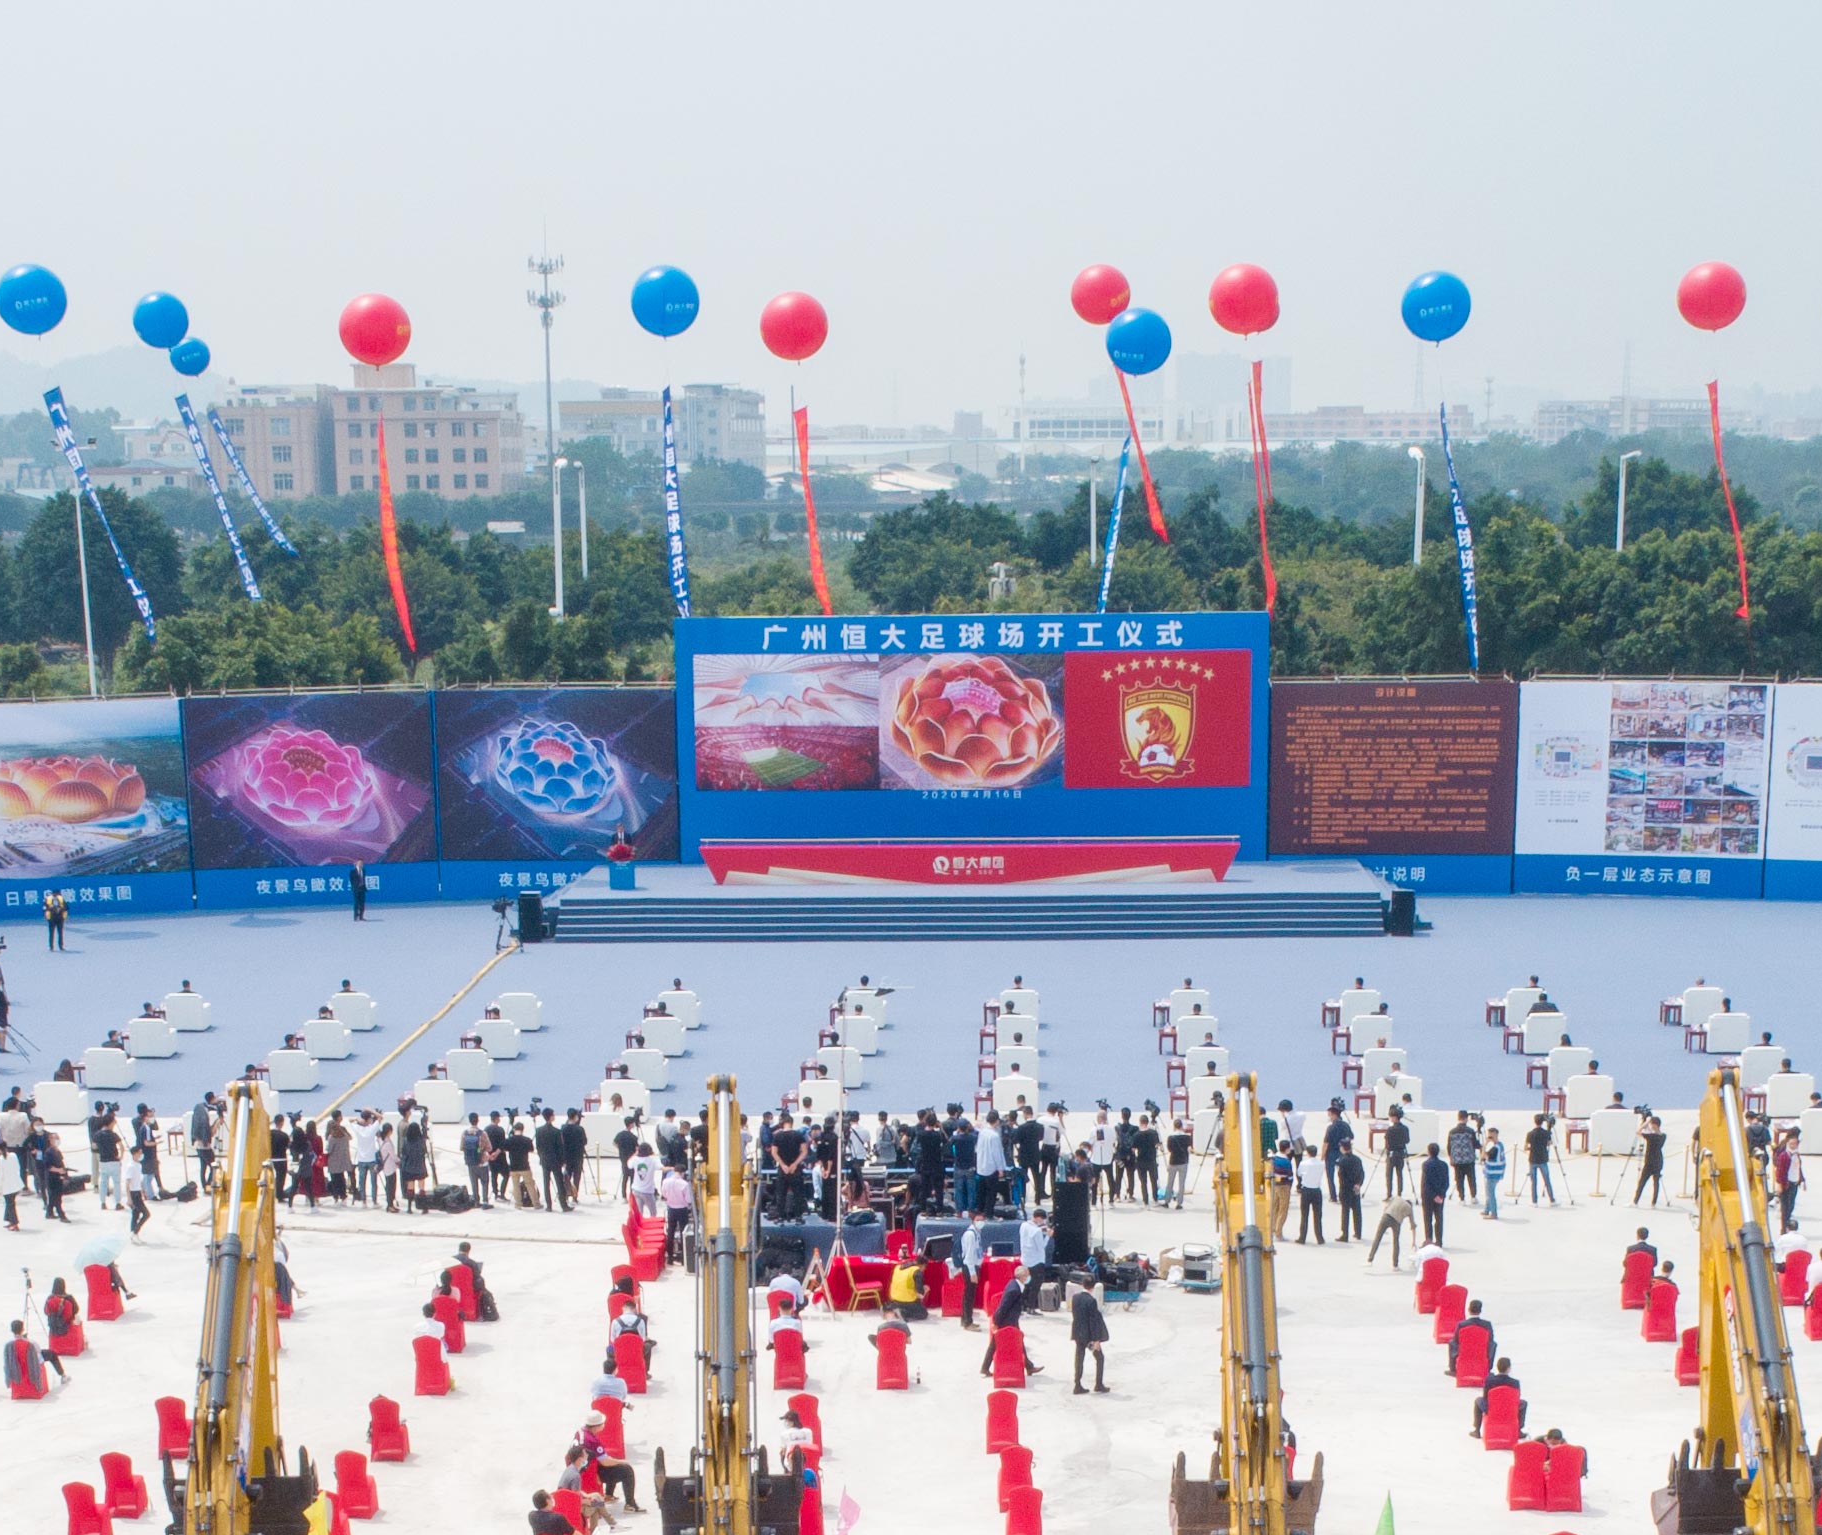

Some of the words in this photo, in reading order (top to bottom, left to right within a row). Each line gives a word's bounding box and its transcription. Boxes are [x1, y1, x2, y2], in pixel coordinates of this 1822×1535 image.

[761, 621, 1184, 650] 广州恒大足球场开工仪式
[922, 790, 1023, 800] 2020年4月16日
[952, 856, 1005, 870] 恒大集团
[1565, 865, 1711, 884] 负一层业态示意图
[256, 877, 381, 896] 夜景鸟瞰效图
